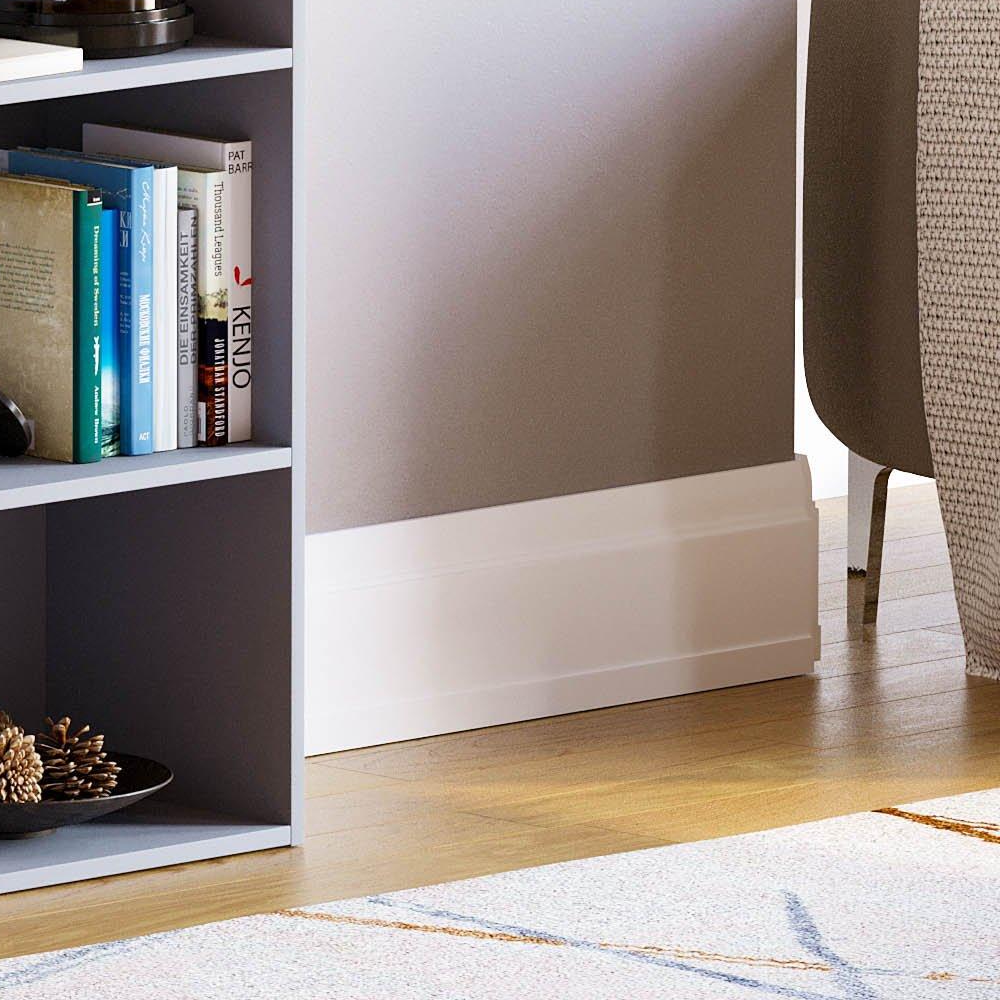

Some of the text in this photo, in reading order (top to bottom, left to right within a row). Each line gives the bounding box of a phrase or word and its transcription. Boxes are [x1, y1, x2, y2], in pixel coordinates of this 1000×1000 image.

[228, 150, 245, 161] PAT
[92, 225, 100, 275] Dreaming
[212, 181, 225, 277] Thousand Leagues
[180, 231, 189, 366] DIE EINSAMKEIT
[214, 338, 225, 437] JONATHAN STANDFORD
[232, 306, 251, 389] KENJO
